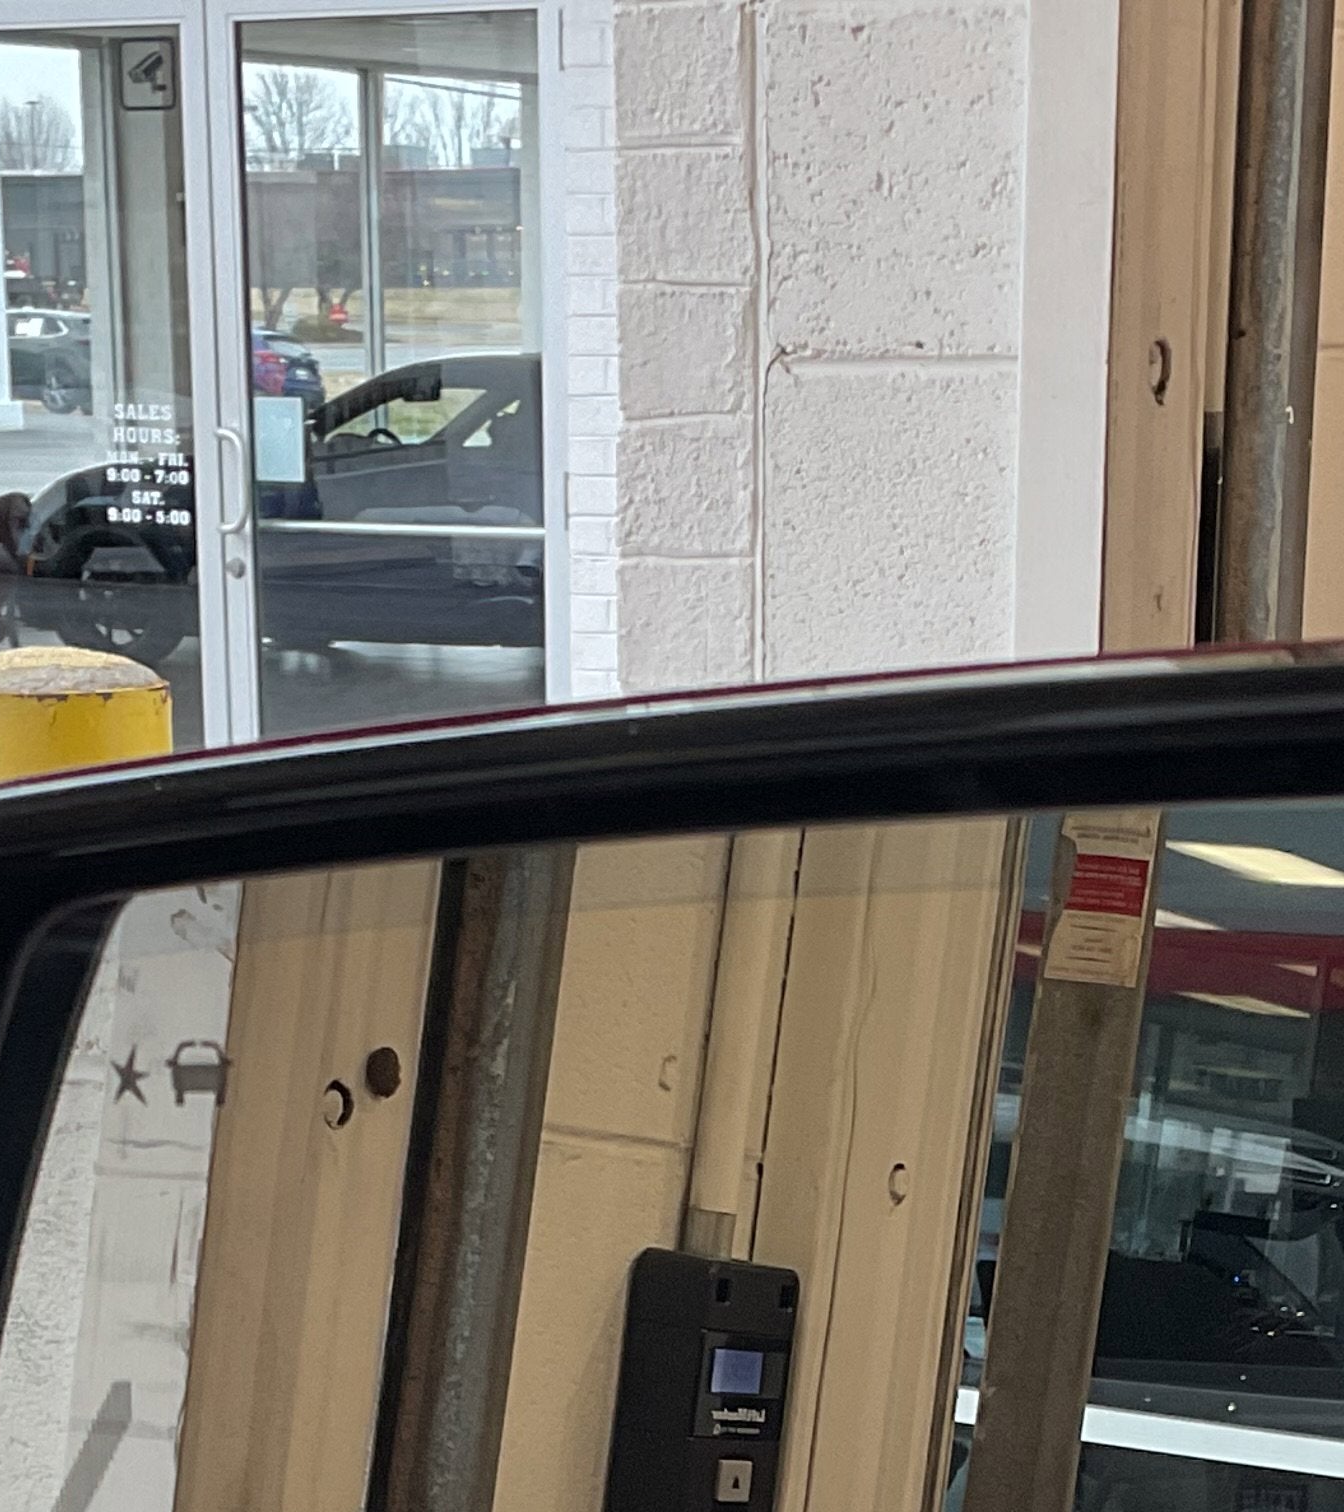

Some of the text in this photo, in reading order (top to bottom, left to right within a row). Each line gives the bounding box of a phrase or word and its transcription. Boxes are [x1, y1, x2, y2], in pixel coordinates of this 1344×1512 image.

[114, 403, 173, 421] SALES
[113, 426, 181, 446] HOURS:
[154, 469, 190, 485] 7:00
[131, 490, 166, 506] SAT.
